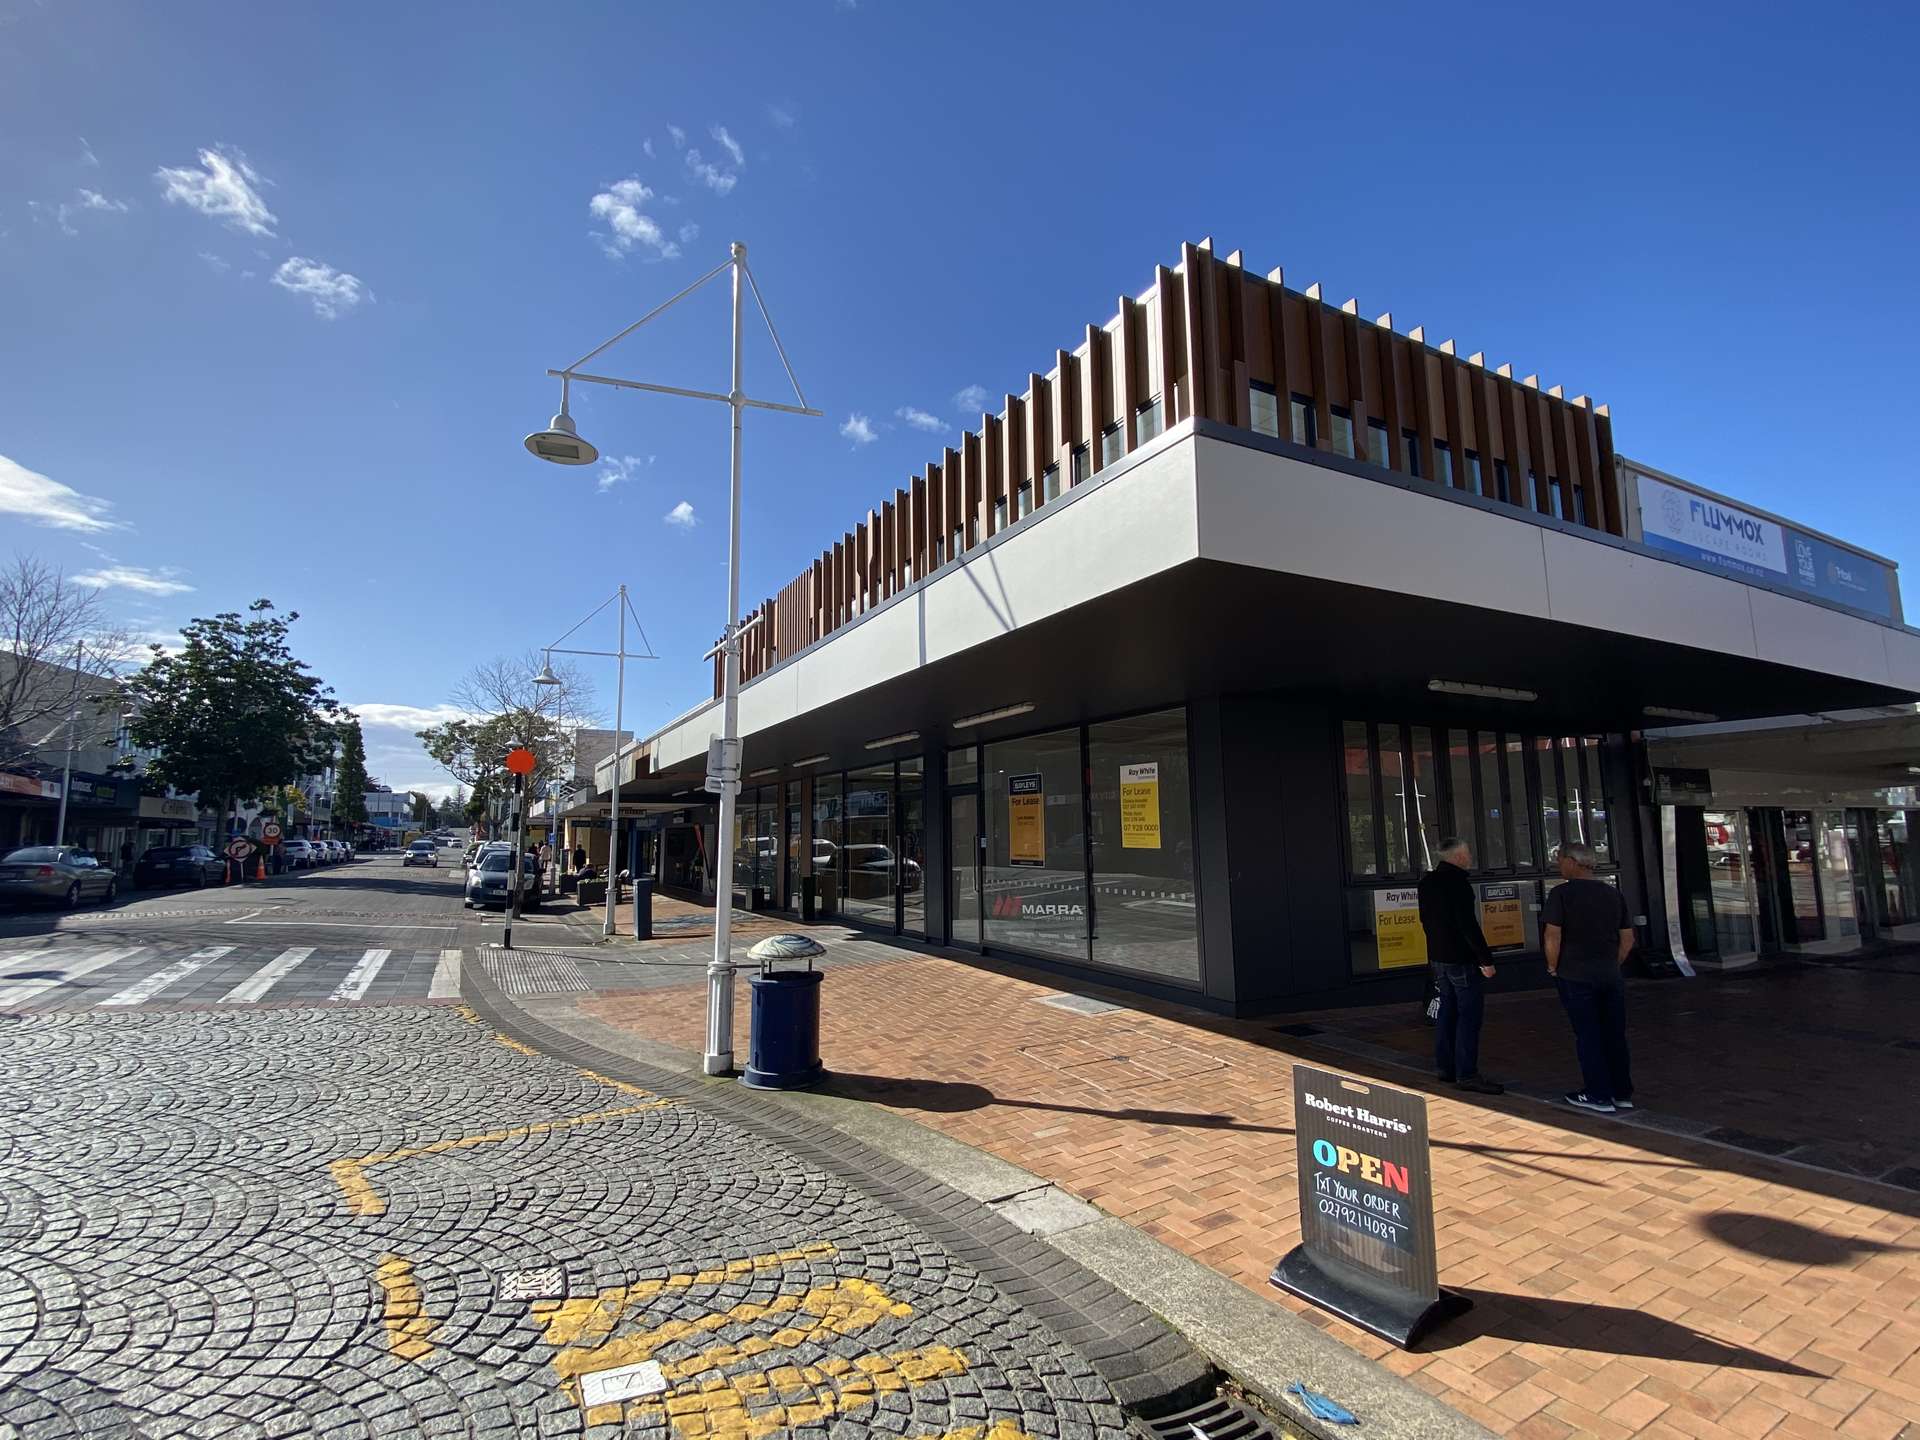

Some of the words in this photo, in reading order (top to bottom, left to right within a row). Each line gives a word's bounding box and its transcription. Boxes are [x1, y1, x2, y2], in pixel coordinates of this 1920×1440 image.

[1690, 500, 1764, 545] FLUMMOX
[1129, 769, 1139, 777] Ray
[1140, 767, 1155, 776] White
[1123, 788, 1132, 796] For
[1134, 787, 1151, 796] Lease
[1012, 797, 1021, 806] For
[1023, 797, 1040, 805] Lease
[1386, 892, 1400, 902] Ray
[1487, 887, 1513, 897] BAYLEYS
[1022, 904, 1084, 915] MARRA
[1485, 904, 1497, 913] For
[1499, 903, 1519, 912] Lease
[1379, 915, 1392, 926] For
[1394, 914, 1416, 925] Lease
[1304, 1092, 1355, 1117] Robert
[1356, 1107, 1407, 1133] Harris
[1326, 1115, 1351, 1128] COFFEE
[1352, 1122, 1388, 1138] ROASTERS
[1312, 1137, 1410, 1194] OPEN
[1334, 1179, 1360, 1204] YOUR
[1363, 1193, 1402, 1220] ORDER
[1318, 1198, 1397, 1243] 0279214089
